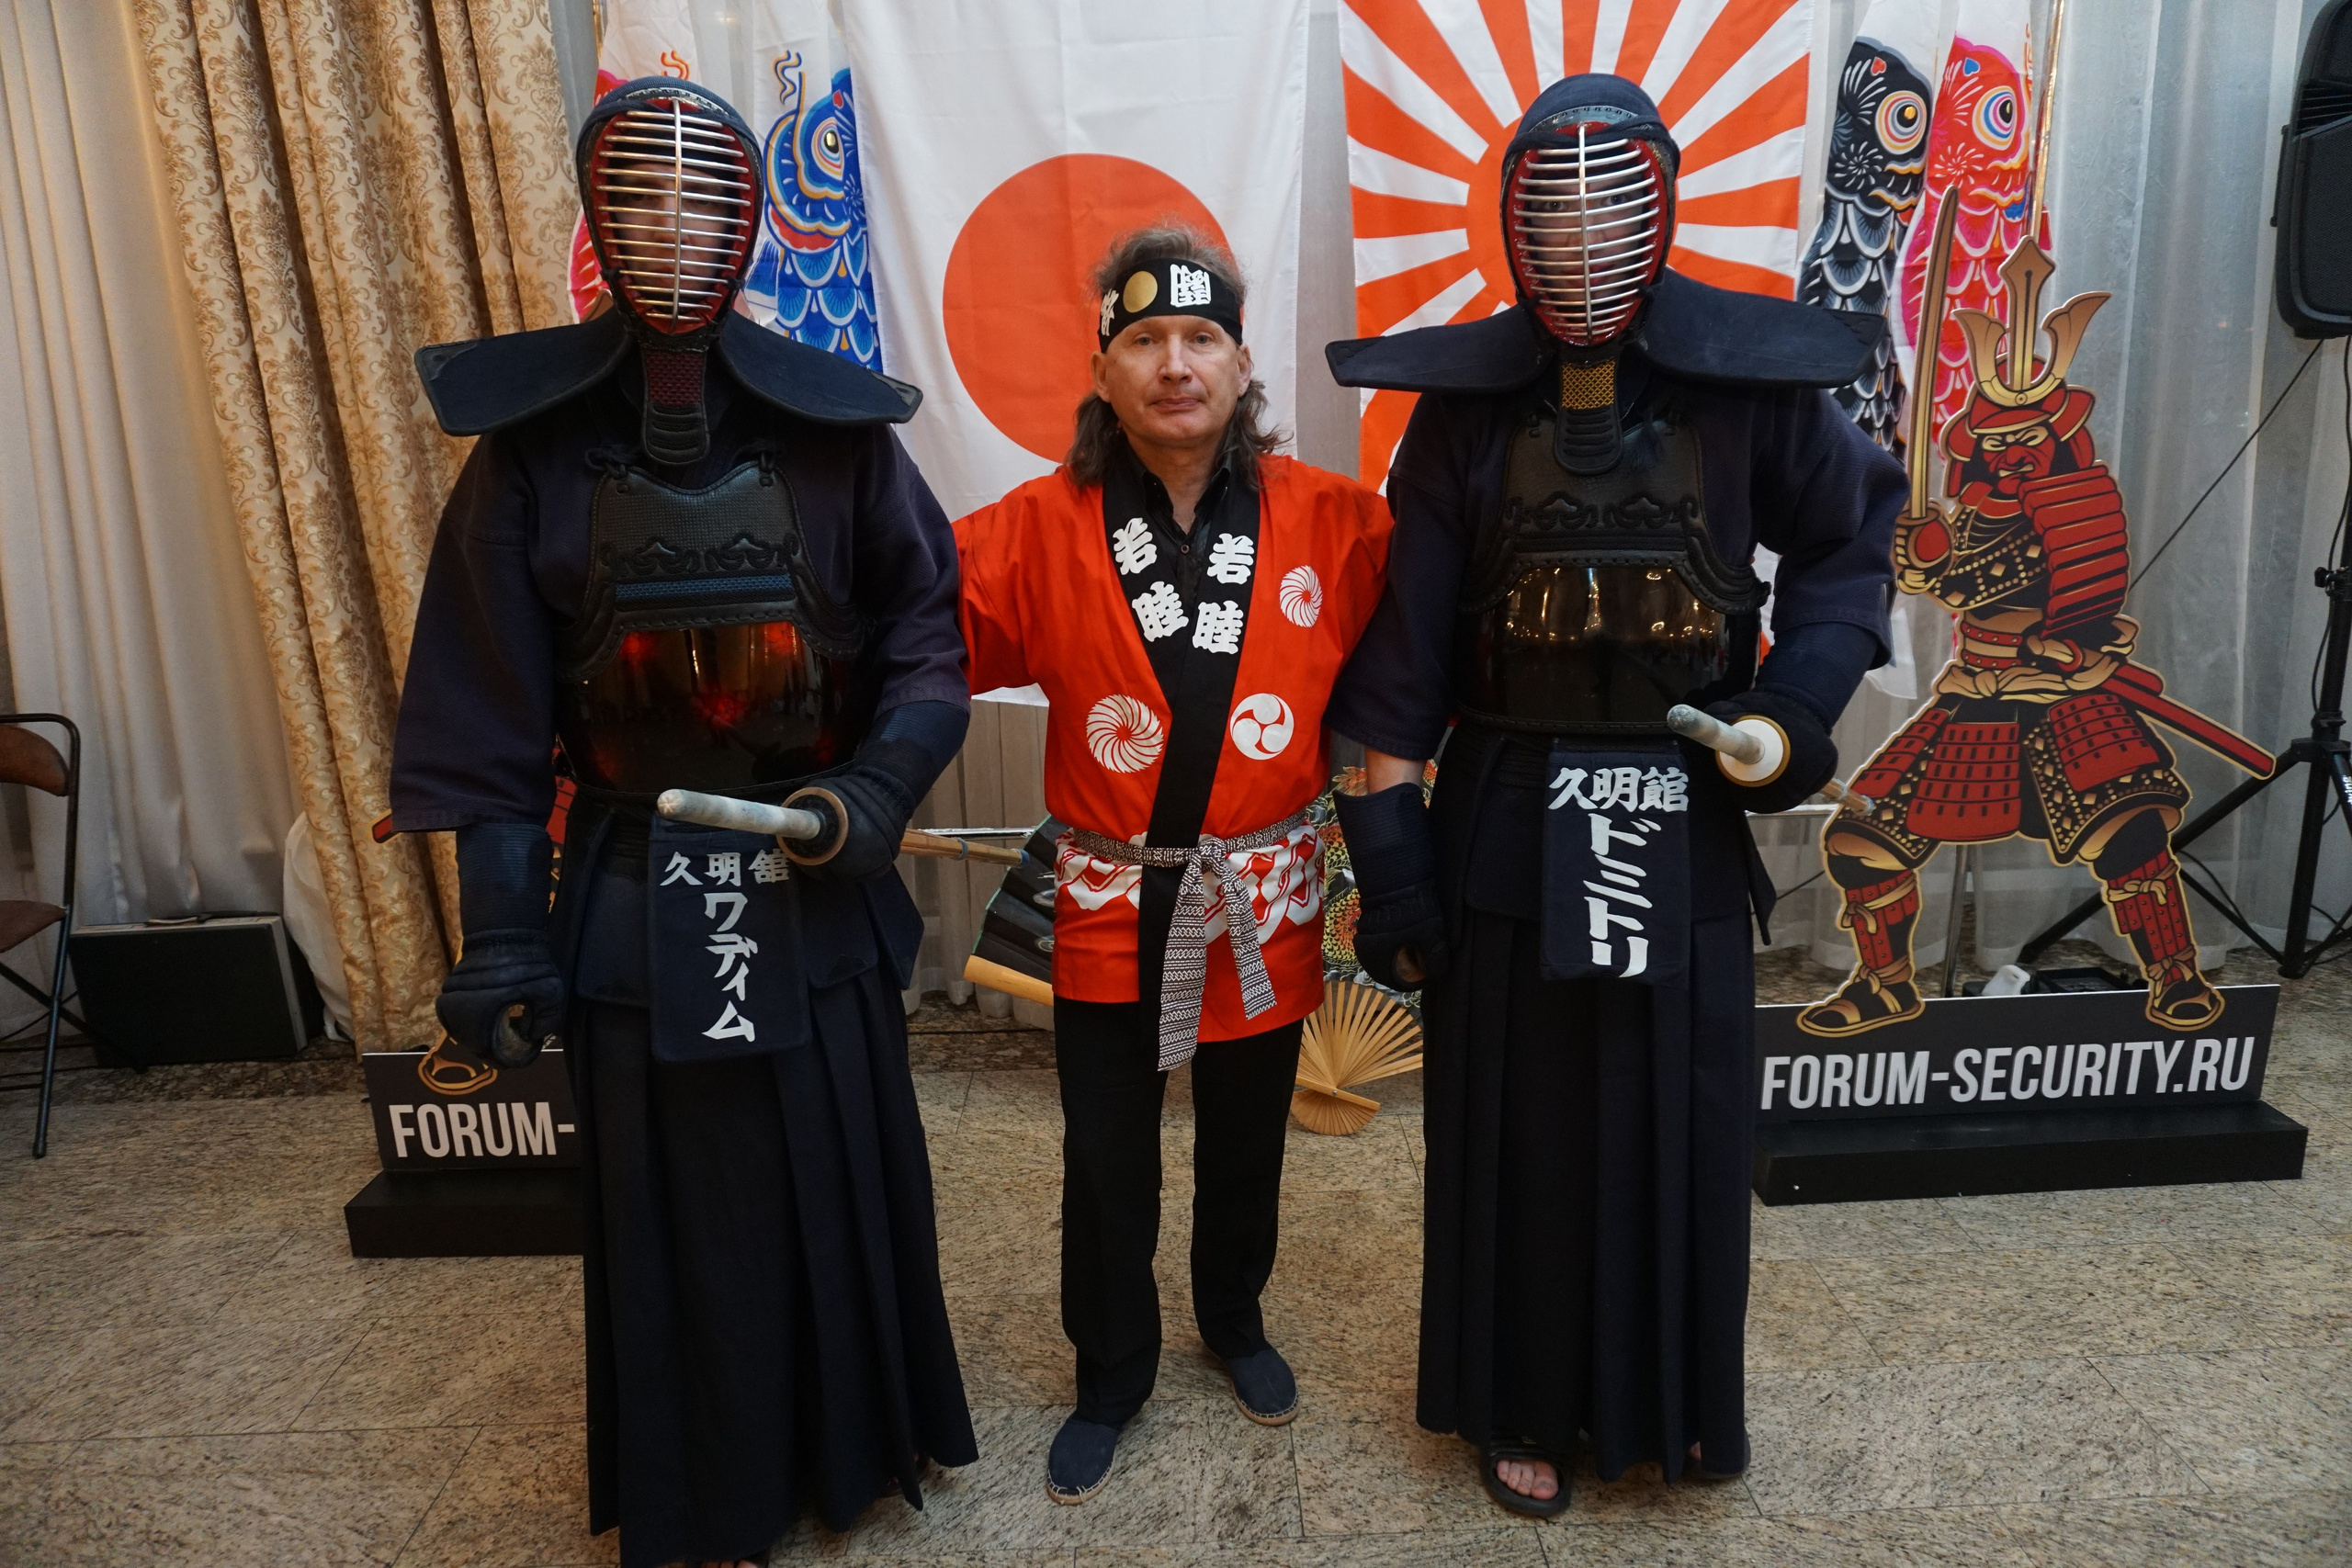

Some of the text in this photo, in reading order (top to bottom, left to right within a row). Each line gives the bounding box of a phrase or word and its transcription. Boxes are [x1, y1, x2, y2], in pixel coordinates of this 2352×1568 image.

[1548, 766, 1690, 813] 久明館
[1583, 813, 1662, 978] ドミトリ
[701, 892, 759, 1043] ワディム
[1760, 1036, 2256, 1110] FORUM-SECURITY.RU
[389, 1102, 575, 1157] FORUM-
